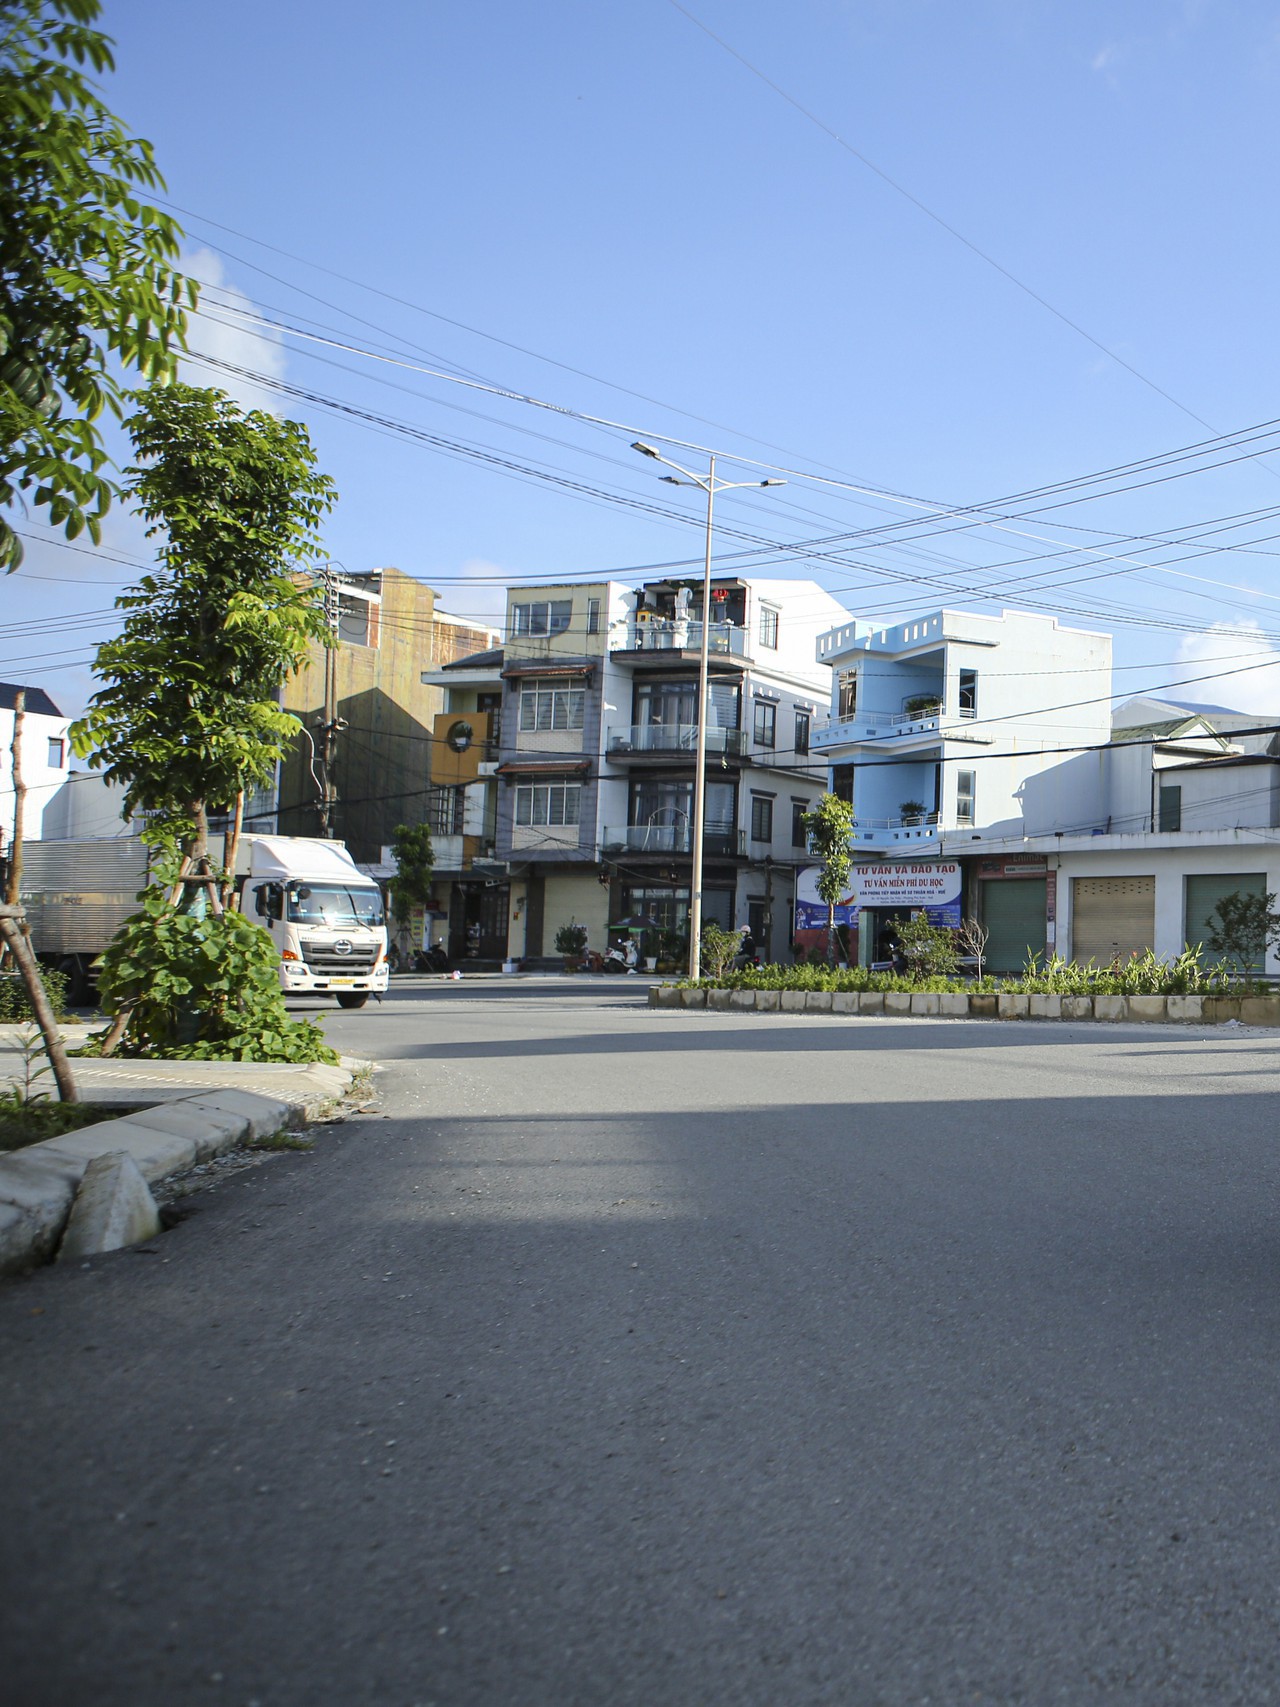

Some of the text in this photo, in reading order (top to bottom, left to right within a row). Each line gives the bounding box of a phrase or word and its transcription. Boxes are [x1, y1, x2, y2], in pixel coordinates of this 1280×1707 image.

[856, 866, 869, 875] TƯ
[936, 865, 956, 875] TẠO
[864, 879, 873, 888] TƯ
[874, 876, 889, 888] VẤN
[930, 879, 944, 888] HỌC
